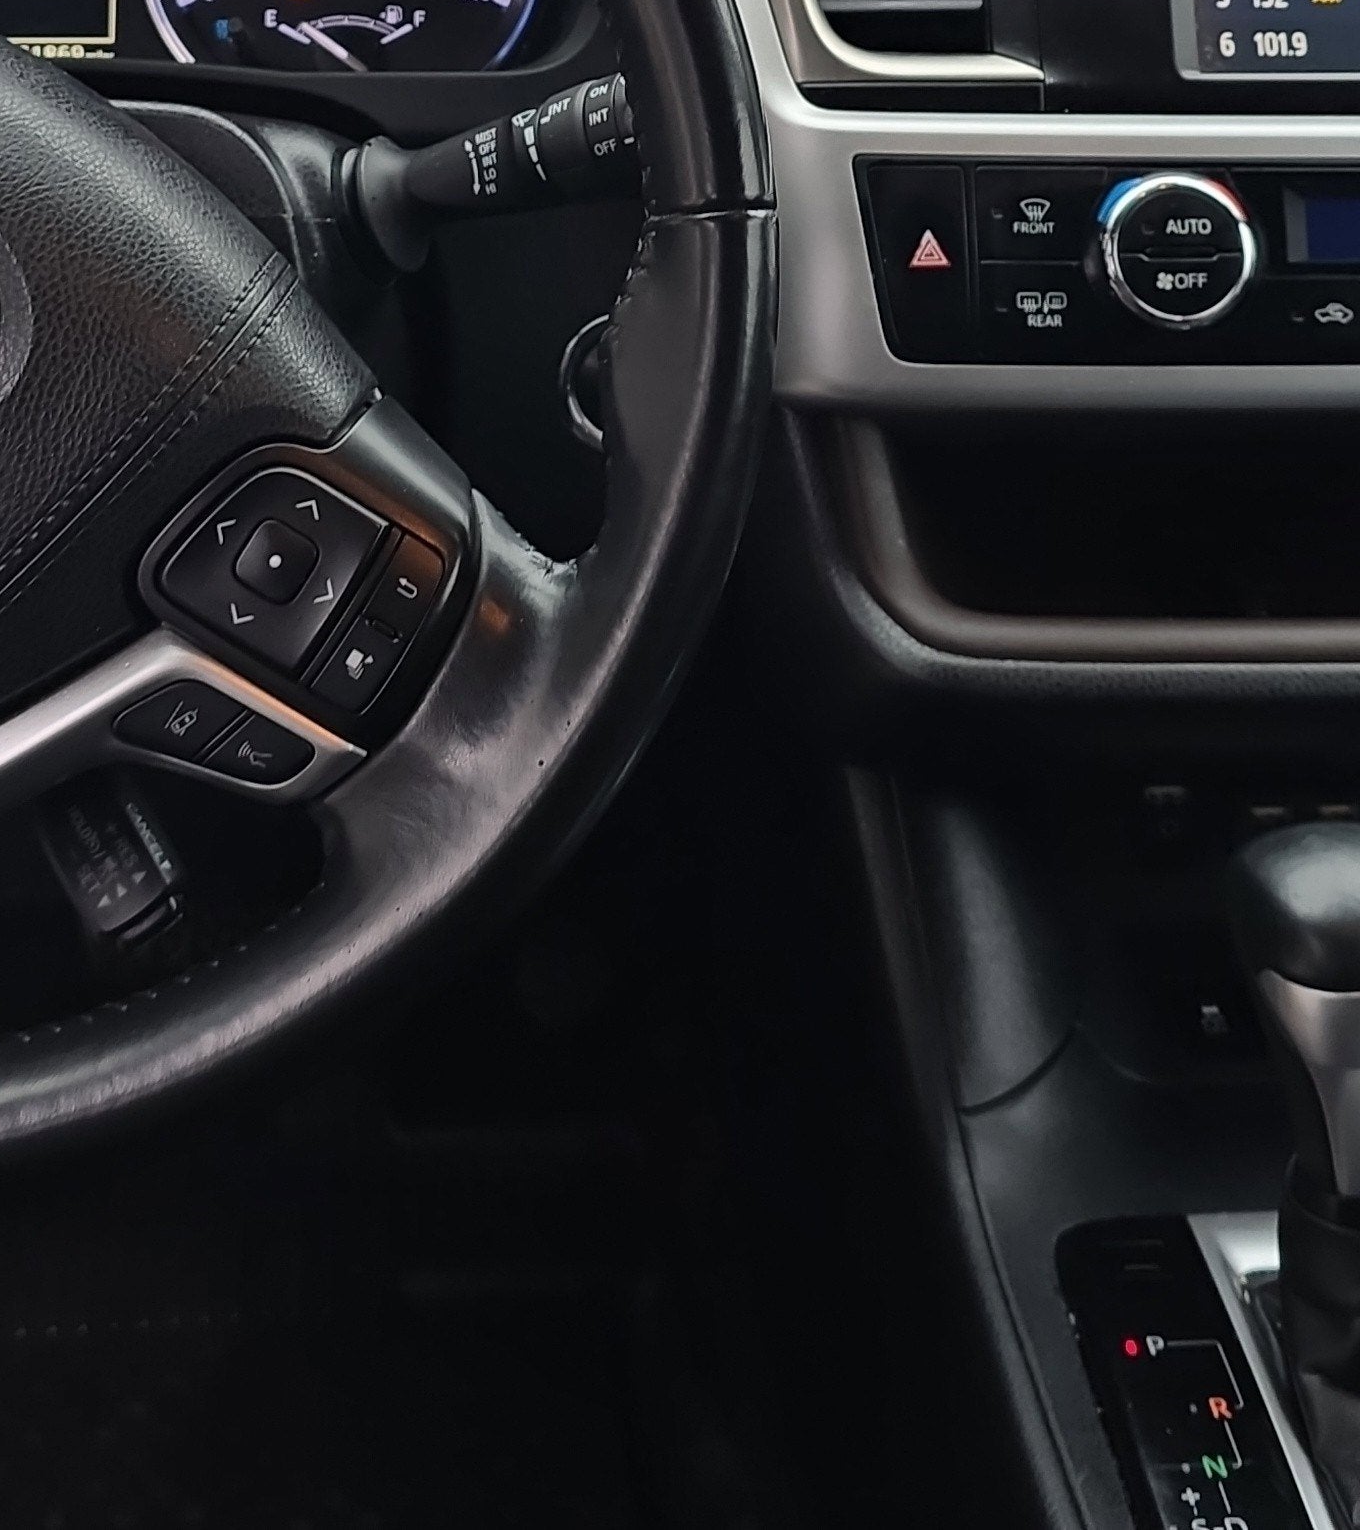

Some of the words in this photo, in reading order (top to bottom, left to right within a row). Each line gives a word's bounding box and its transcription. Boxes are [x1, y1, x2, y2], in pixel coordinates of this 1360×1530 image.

[264, 8, 278, 28] E
[413, 9, 426, 28] F
[1219, 31, 1236, 58] 6
[1253, 31, 1308, 57] 101.9
[589, 83, 609, 98] ON
[547, 97, 571, 116] INT
[588, 107, 609, 126] INT
[478, 141, 497, 156] OFF
[594, 138, 617, 157] OFF
[483, 167, 497, 182] LO
[1012, 221, 1055, 234] FRONT
[1165, 219, 1212, 235] AUTO
[1174, 272, 1208, 289] OFF
[1027, 314, 1063, 328] REAR
[1145, 1335, 1164, 1356] P
[1208, 1396, 1232, 1419] R
[1201, 1455, 1228, 1479] N
